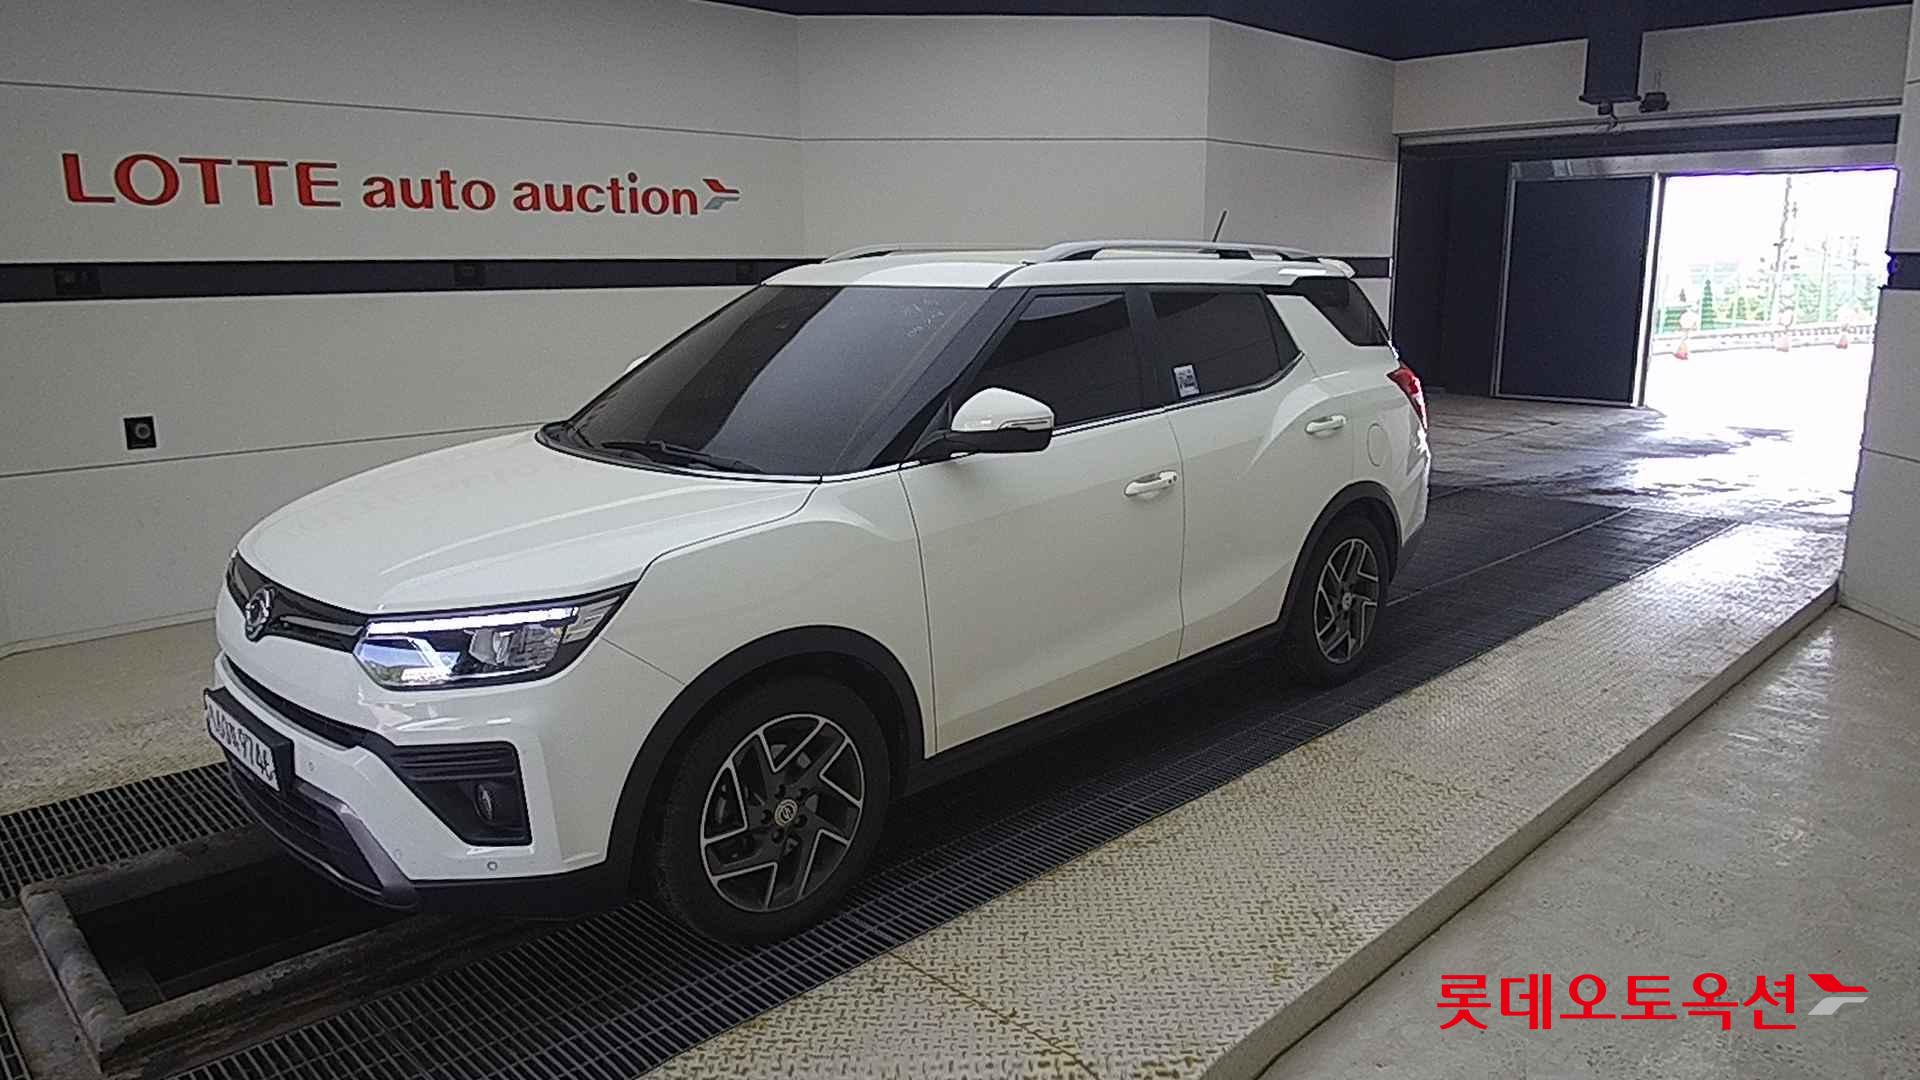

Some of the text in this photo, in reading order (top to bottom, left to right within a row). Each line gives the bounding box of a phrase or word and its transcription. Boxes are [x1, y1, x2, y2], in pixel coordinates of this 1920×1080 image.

[62, 152, 699, 215] LOTTE auto auction
